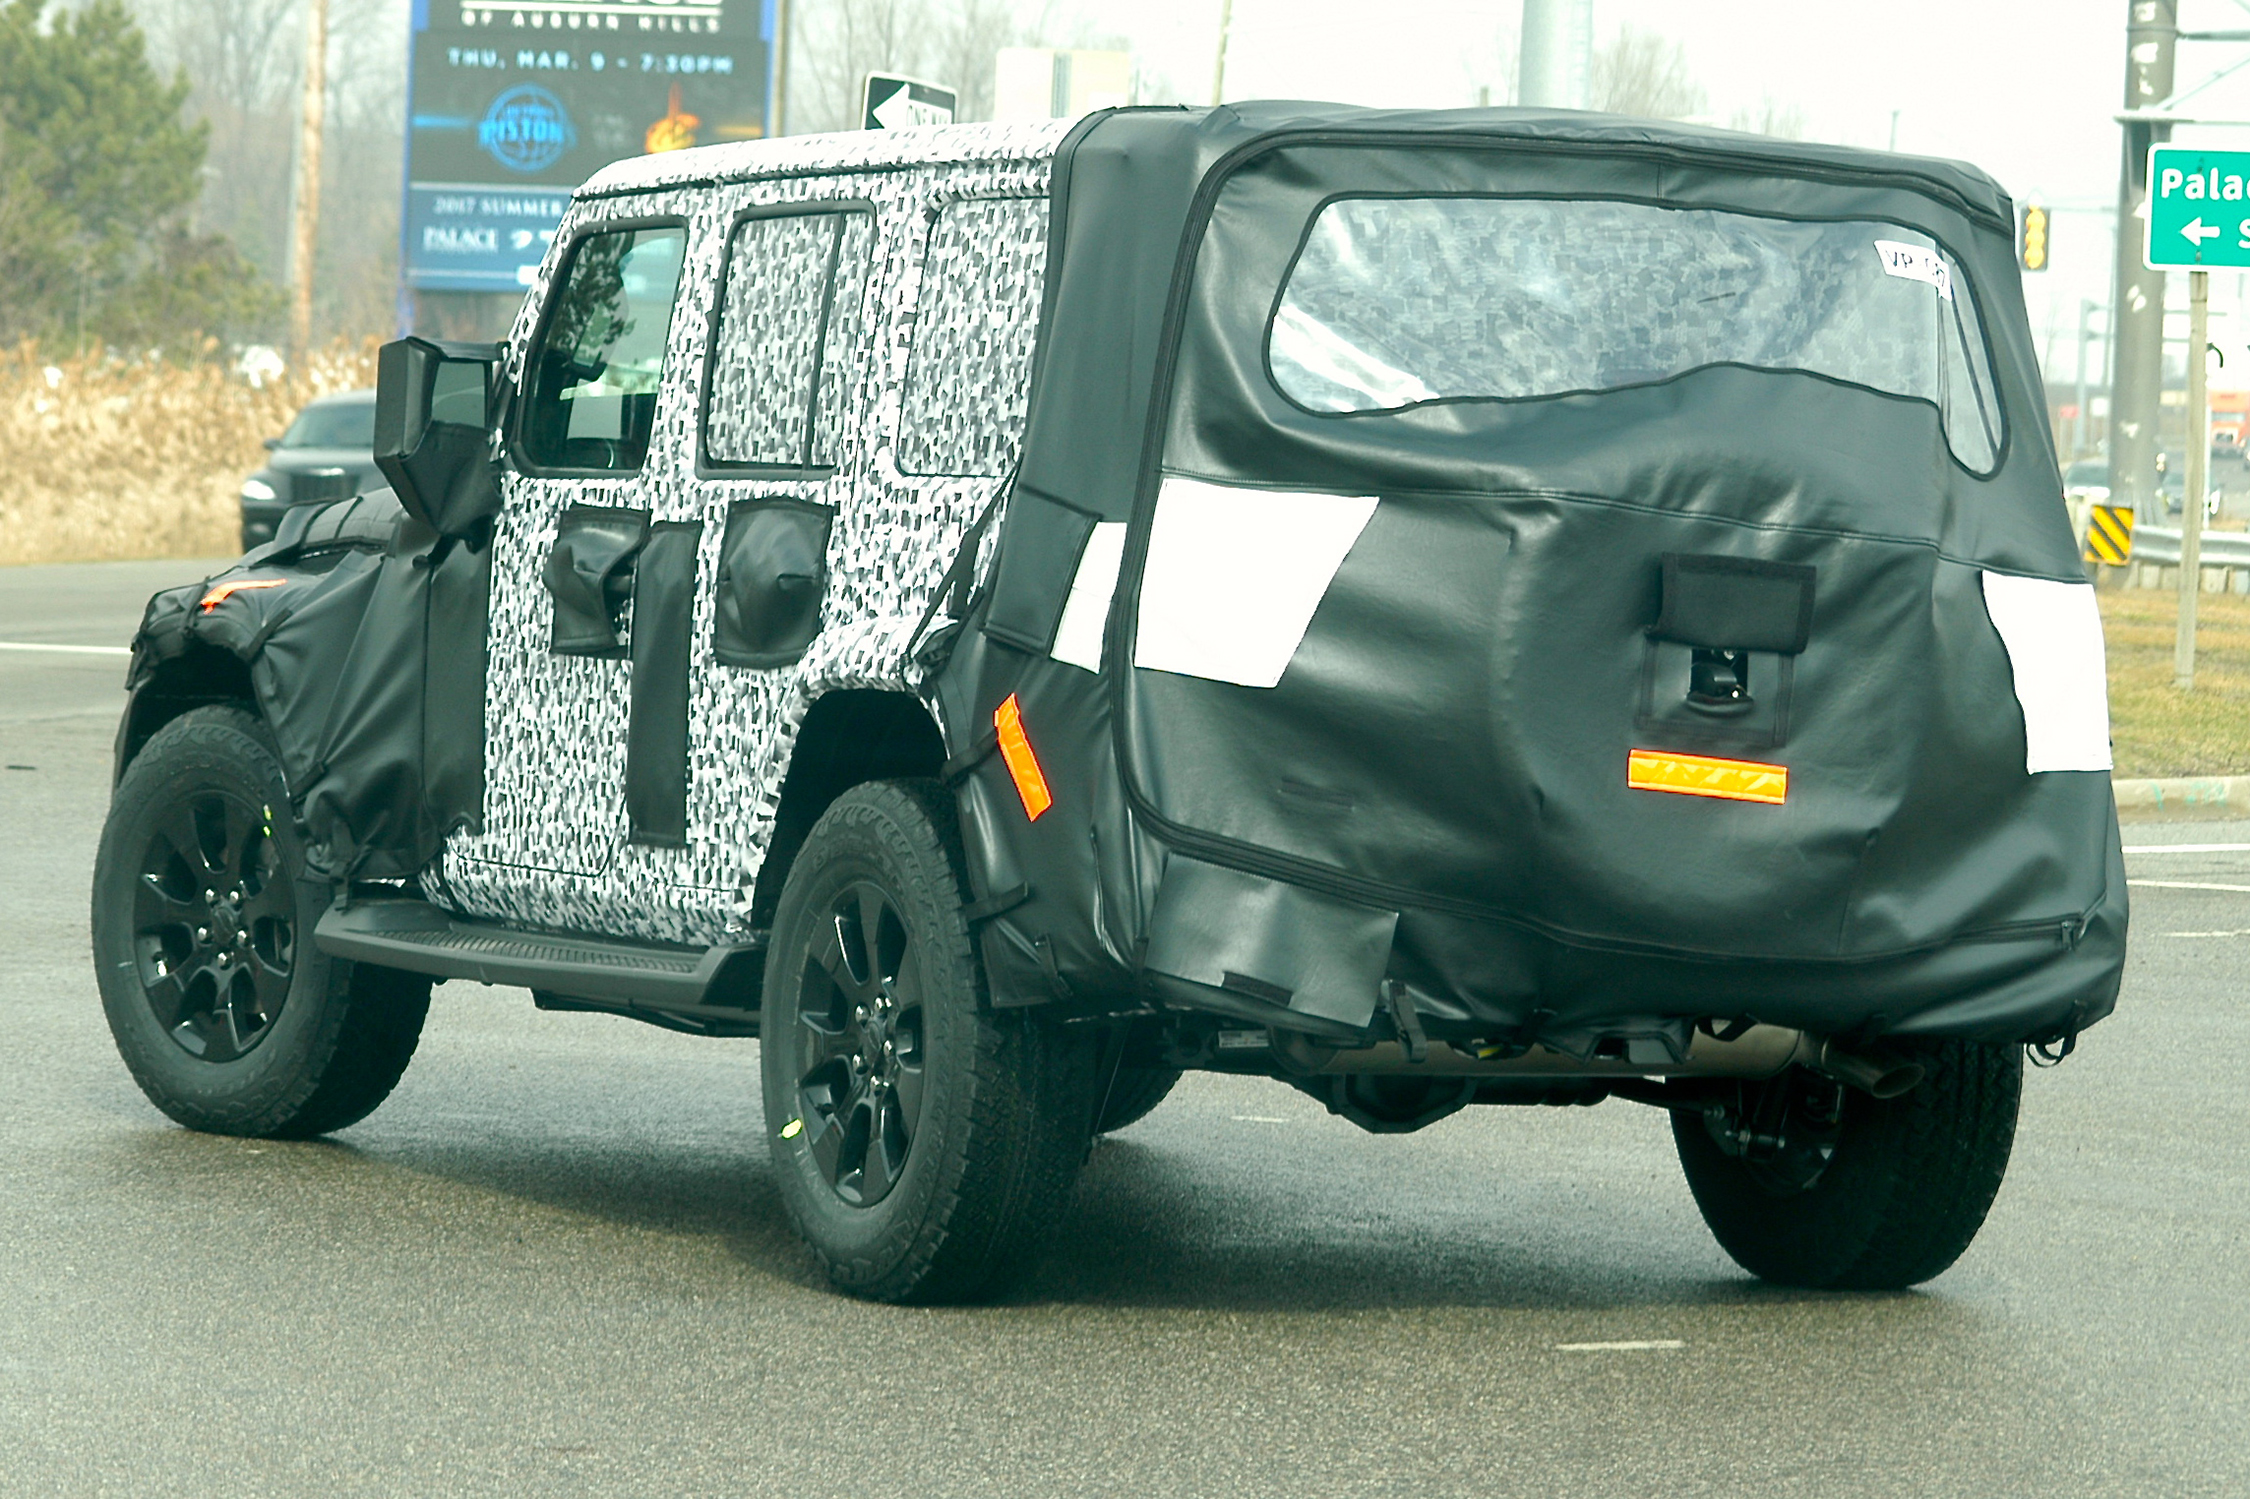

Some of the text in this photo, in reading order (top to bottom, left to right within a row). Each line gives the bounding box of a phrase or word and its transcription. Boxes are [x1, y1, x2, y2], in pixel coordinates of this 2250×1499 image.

[461, 9, 719, 34] OF AUBURN HILLS
[641, 53, 733, 74] 7:30PM
[2160, 167, 2250, 200] Pala
[480, 197, 563, 217] SUMMER
